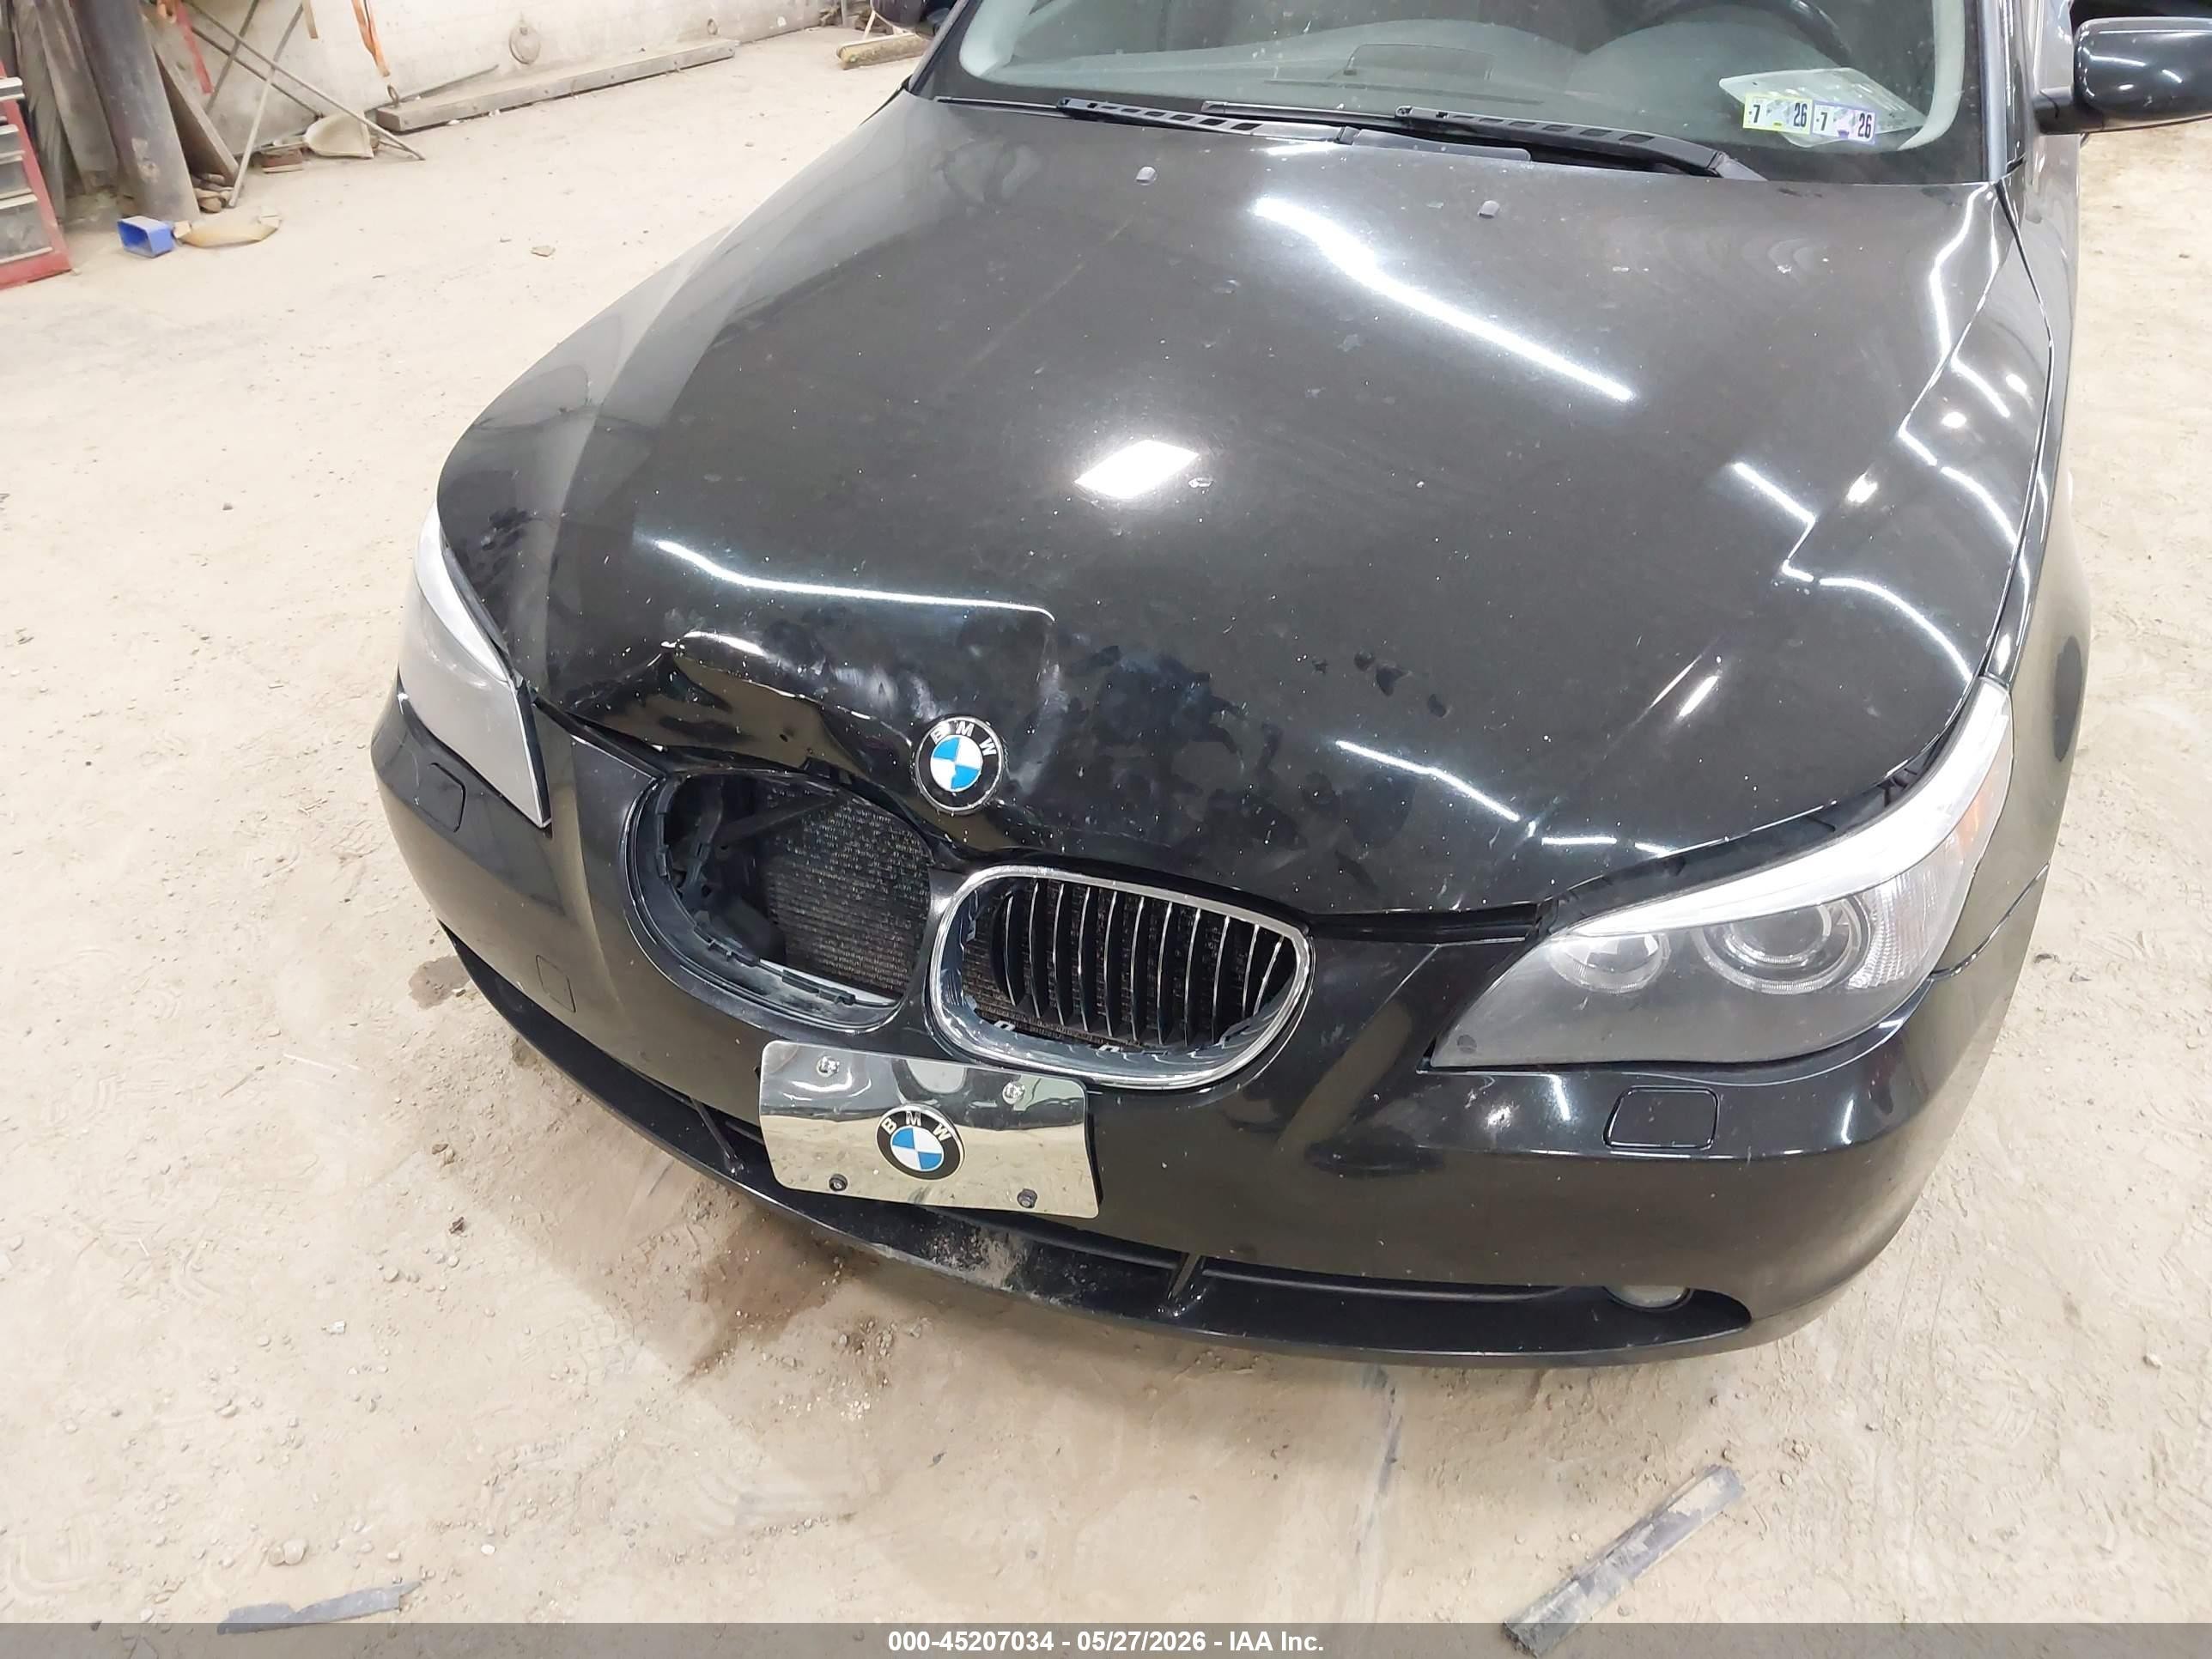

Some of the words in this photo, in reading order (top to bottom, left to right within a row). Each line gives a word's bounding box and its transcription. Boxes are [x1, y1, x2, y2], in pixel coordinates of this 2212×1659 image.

[1793, 102, 1808, 127] 26
[1857, 112, 1872, 138] 26
[930, 720, 997, 756] BMW
[881, 1110, 952, 1141] BMW
